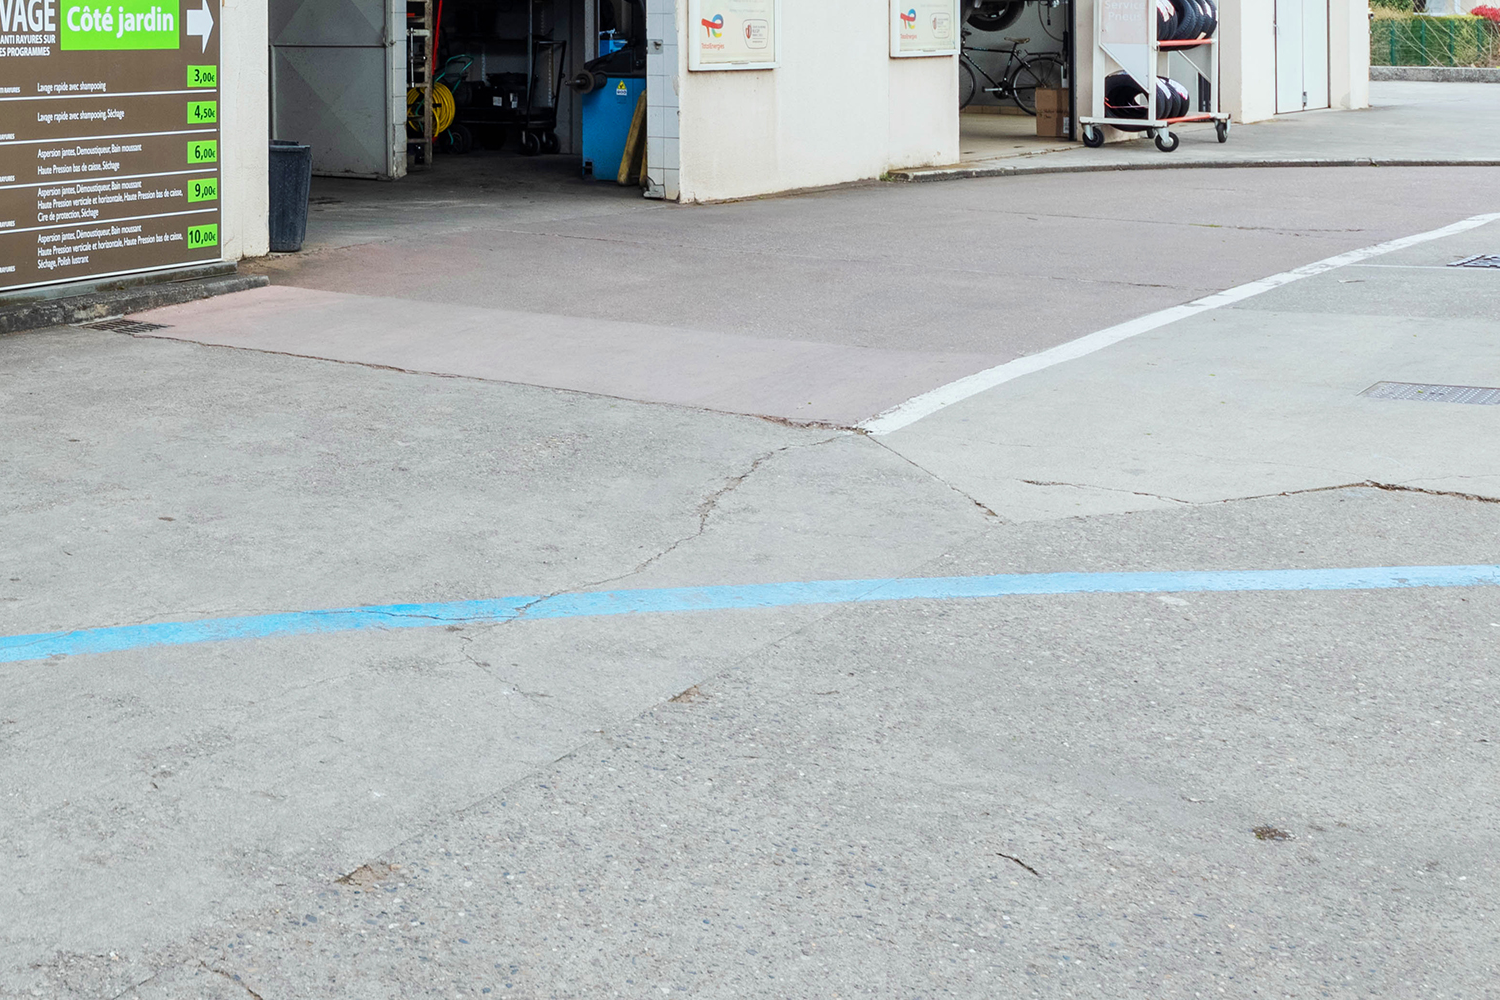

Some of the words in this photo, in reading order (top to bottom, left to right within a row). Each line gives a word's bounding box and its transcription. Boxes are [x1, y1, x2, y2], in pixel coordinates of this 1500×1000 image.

[1104, 0, 1145, 9] Service
[66, 5, 114, 32] Côté
[116, 6, 174, 38] jardin
[1109, 12, 1141, 21] Pneus
[0, 35, 15, 45] ANTI
[15, 35, 43, 44] RAYURES
[43, 34, 56, 44] SUR
[7, 47, 50, 57] PROGRAMMES
[194, 69, 215, 84] 3,00€
[37, 83, 53, 94] Lavage
[54, 82, 69, 93] rapide
[80, 81, 106, 92] shampooing
[37, 112, 53, 123] Lavage
[54, 111, 69, 123] rapide
[194, 105, 215, 120] 4,50€
[37, 148, 61, 160] Aspersion
[194, 145, 215, 160] 6,00€
[37, 165, 52, 175] Haute
[53, 163, 72, 174] Pression
[81, 163, 87, 172] de
[37, 187, 61, 199] Aspersion
[194, 183, 216, 199] 9,00€
[37, 200, 52, 210] Haute
[53, 198, 72, 208] Pression
[73, 196, 91, 206] verticale
[124, 193, 137, 202] Haute
[138, 190, 155, 200] Pression
[37, 212, 48, 222] Cire
[49, 212, 55, 221] de
[37, 232, 61, 244] Aspersion
[188, 229, 216, 245] 10,00€
[37, 247, 52, 257] Haute
[53, 245, 72, 255] Pression
[73, 242, 91, 253] verticale
[124, 237, 137, 246] Haute
[138, 235, 155, 244] Pression
